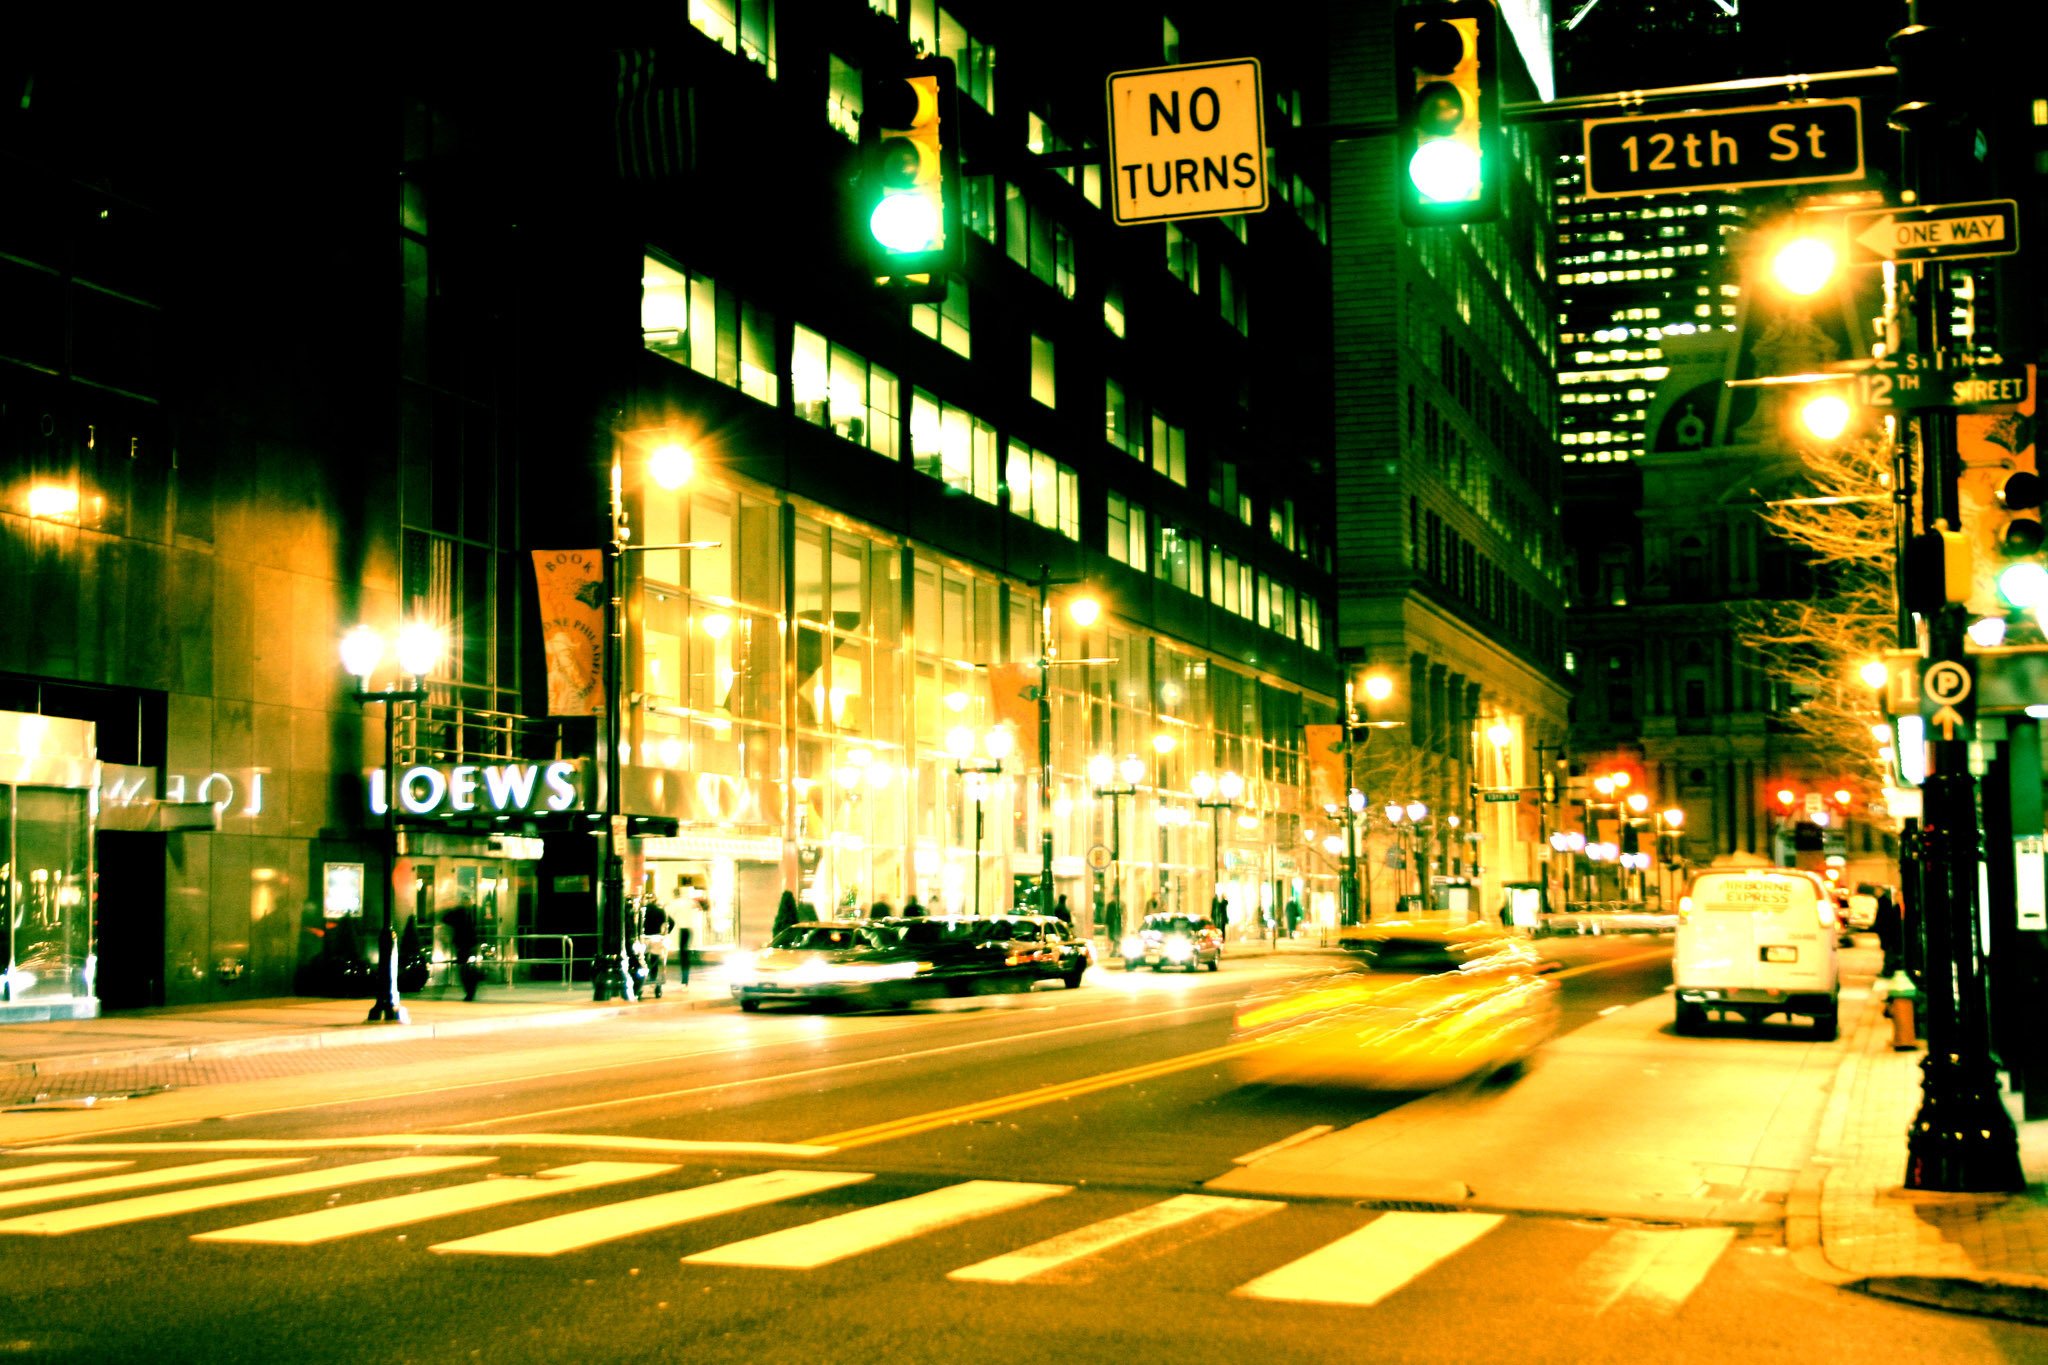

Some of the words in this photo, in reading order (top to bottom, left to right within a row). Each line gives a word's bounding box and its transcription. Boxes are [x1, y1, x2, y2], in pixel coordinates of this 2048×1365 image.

[1149, 86, 1221, 136] NO
[1621, 129, 1739, 172] 12th
[1769, 123, 1827, 162] St
[1121, 152, 1257, 200] TURNS
[1897, 223, 1942, 245] ONE
[1951, 219, 1997, 240] WAY
[1952, 378, 2023, 403] STREET
[545, 552, 594, 574] BOOK
[369, 762, 578, 814] LOEWS
[1726, 892, 1789, 903] EXPRESS
